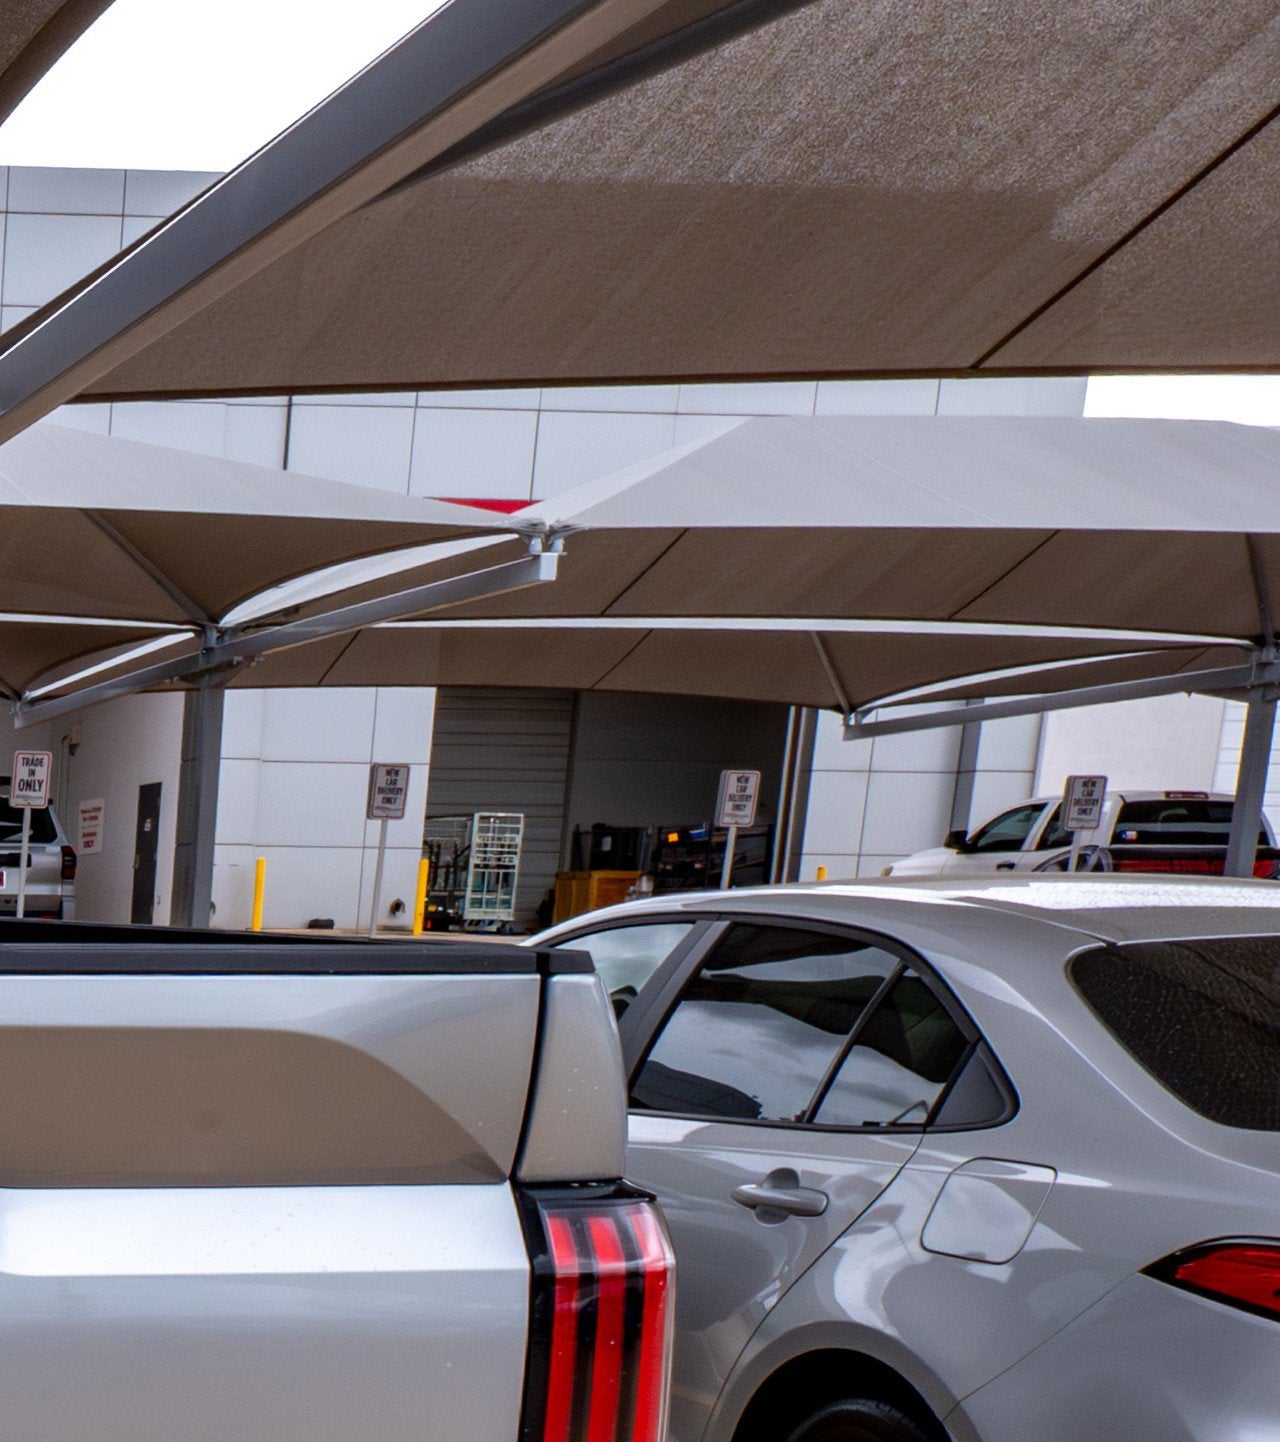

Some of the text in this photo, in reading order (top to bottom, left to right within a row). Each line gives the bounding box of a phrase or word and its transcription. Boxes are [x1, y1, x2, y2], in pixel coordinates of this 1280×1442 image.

[21, 757, 44, 767] TRADE
[28, 768, 36, 777] IN
[18, 779, 44, 792] ONLY
